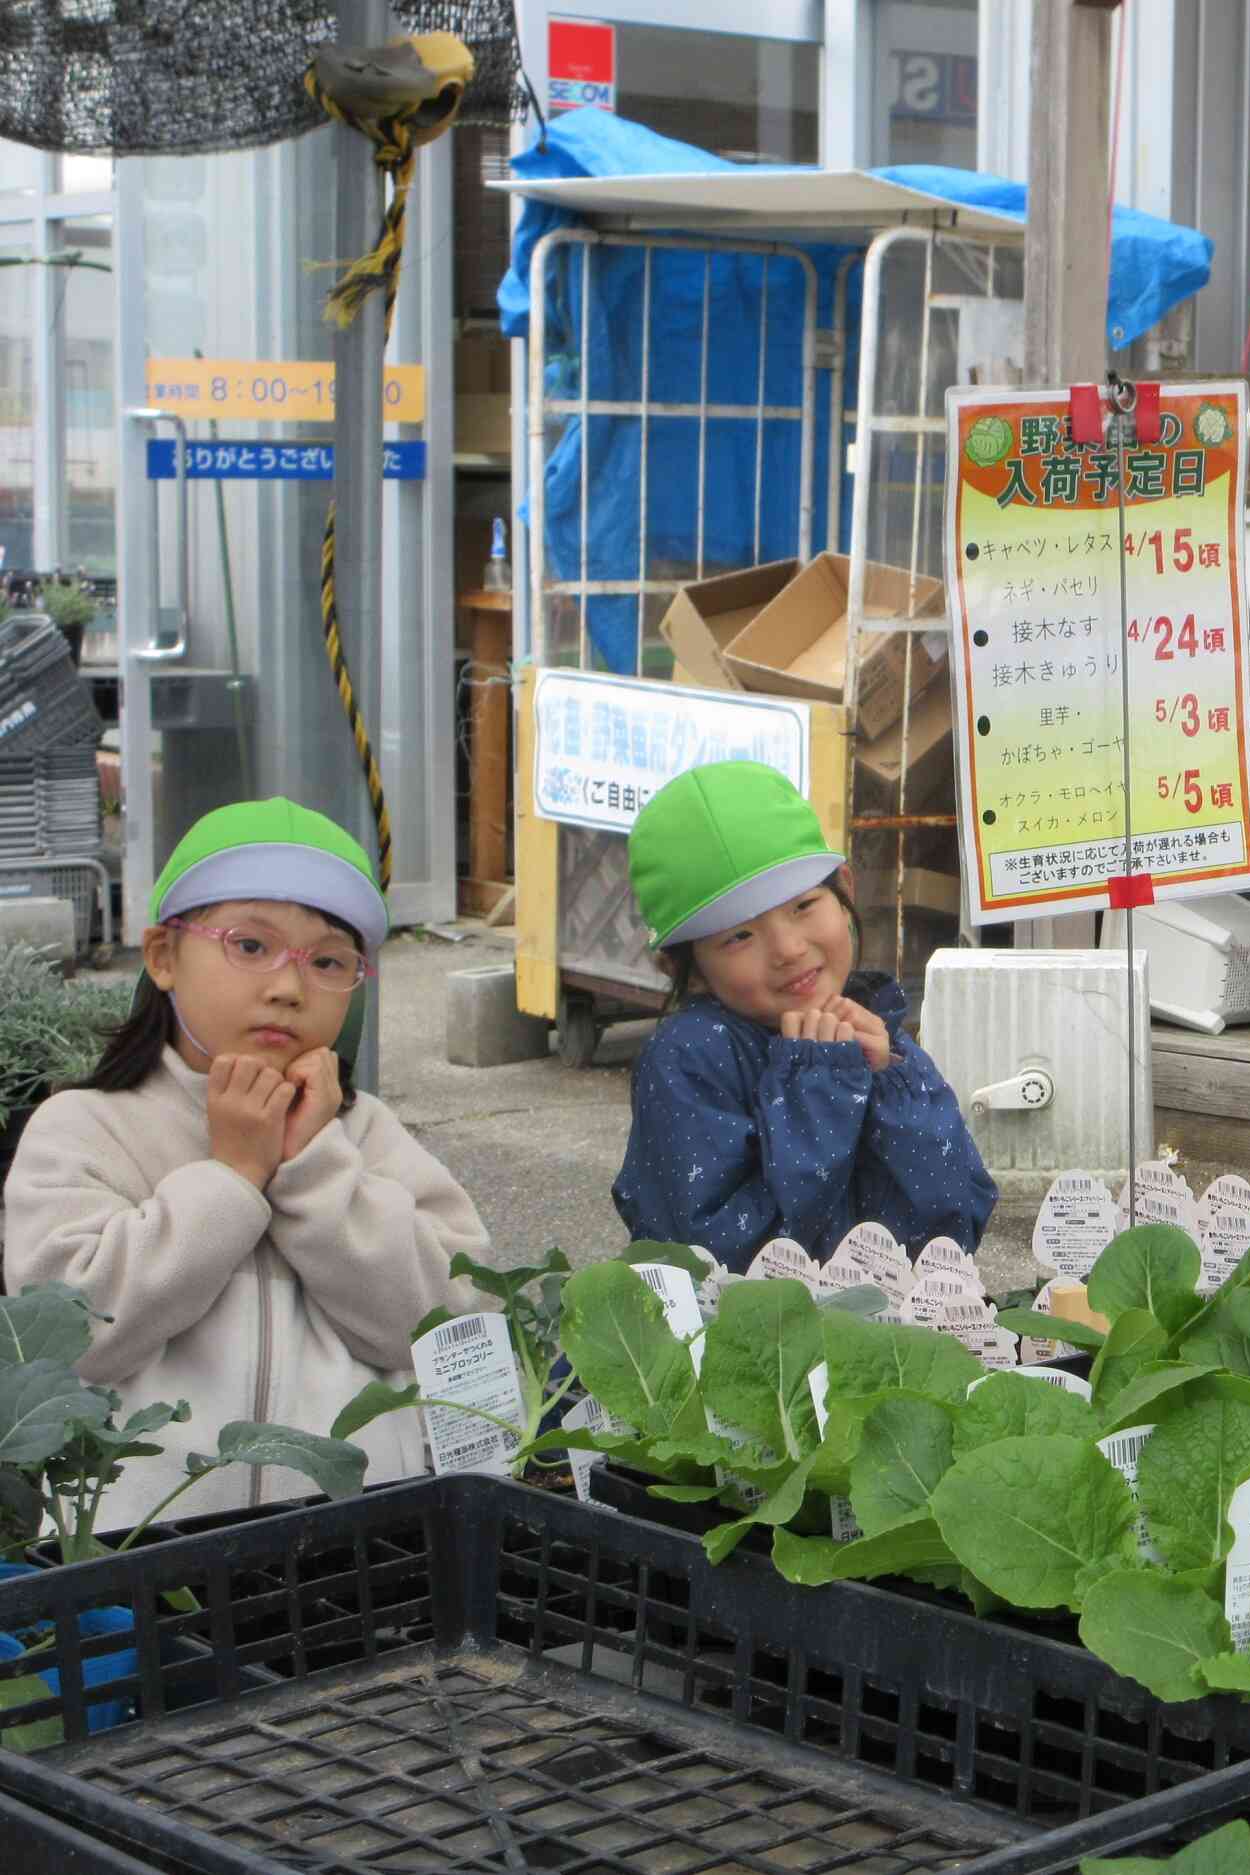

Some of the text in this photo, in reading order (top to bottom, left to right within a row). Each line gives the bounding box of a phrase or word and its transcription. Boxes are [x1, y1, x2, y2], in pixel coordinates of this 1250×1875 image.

[997, 449, 1206, 508] 入荷予定日
[1013, 615, 1098, 643] 接木なす
[992, 654, 1119, 688] 接木きゅうり
